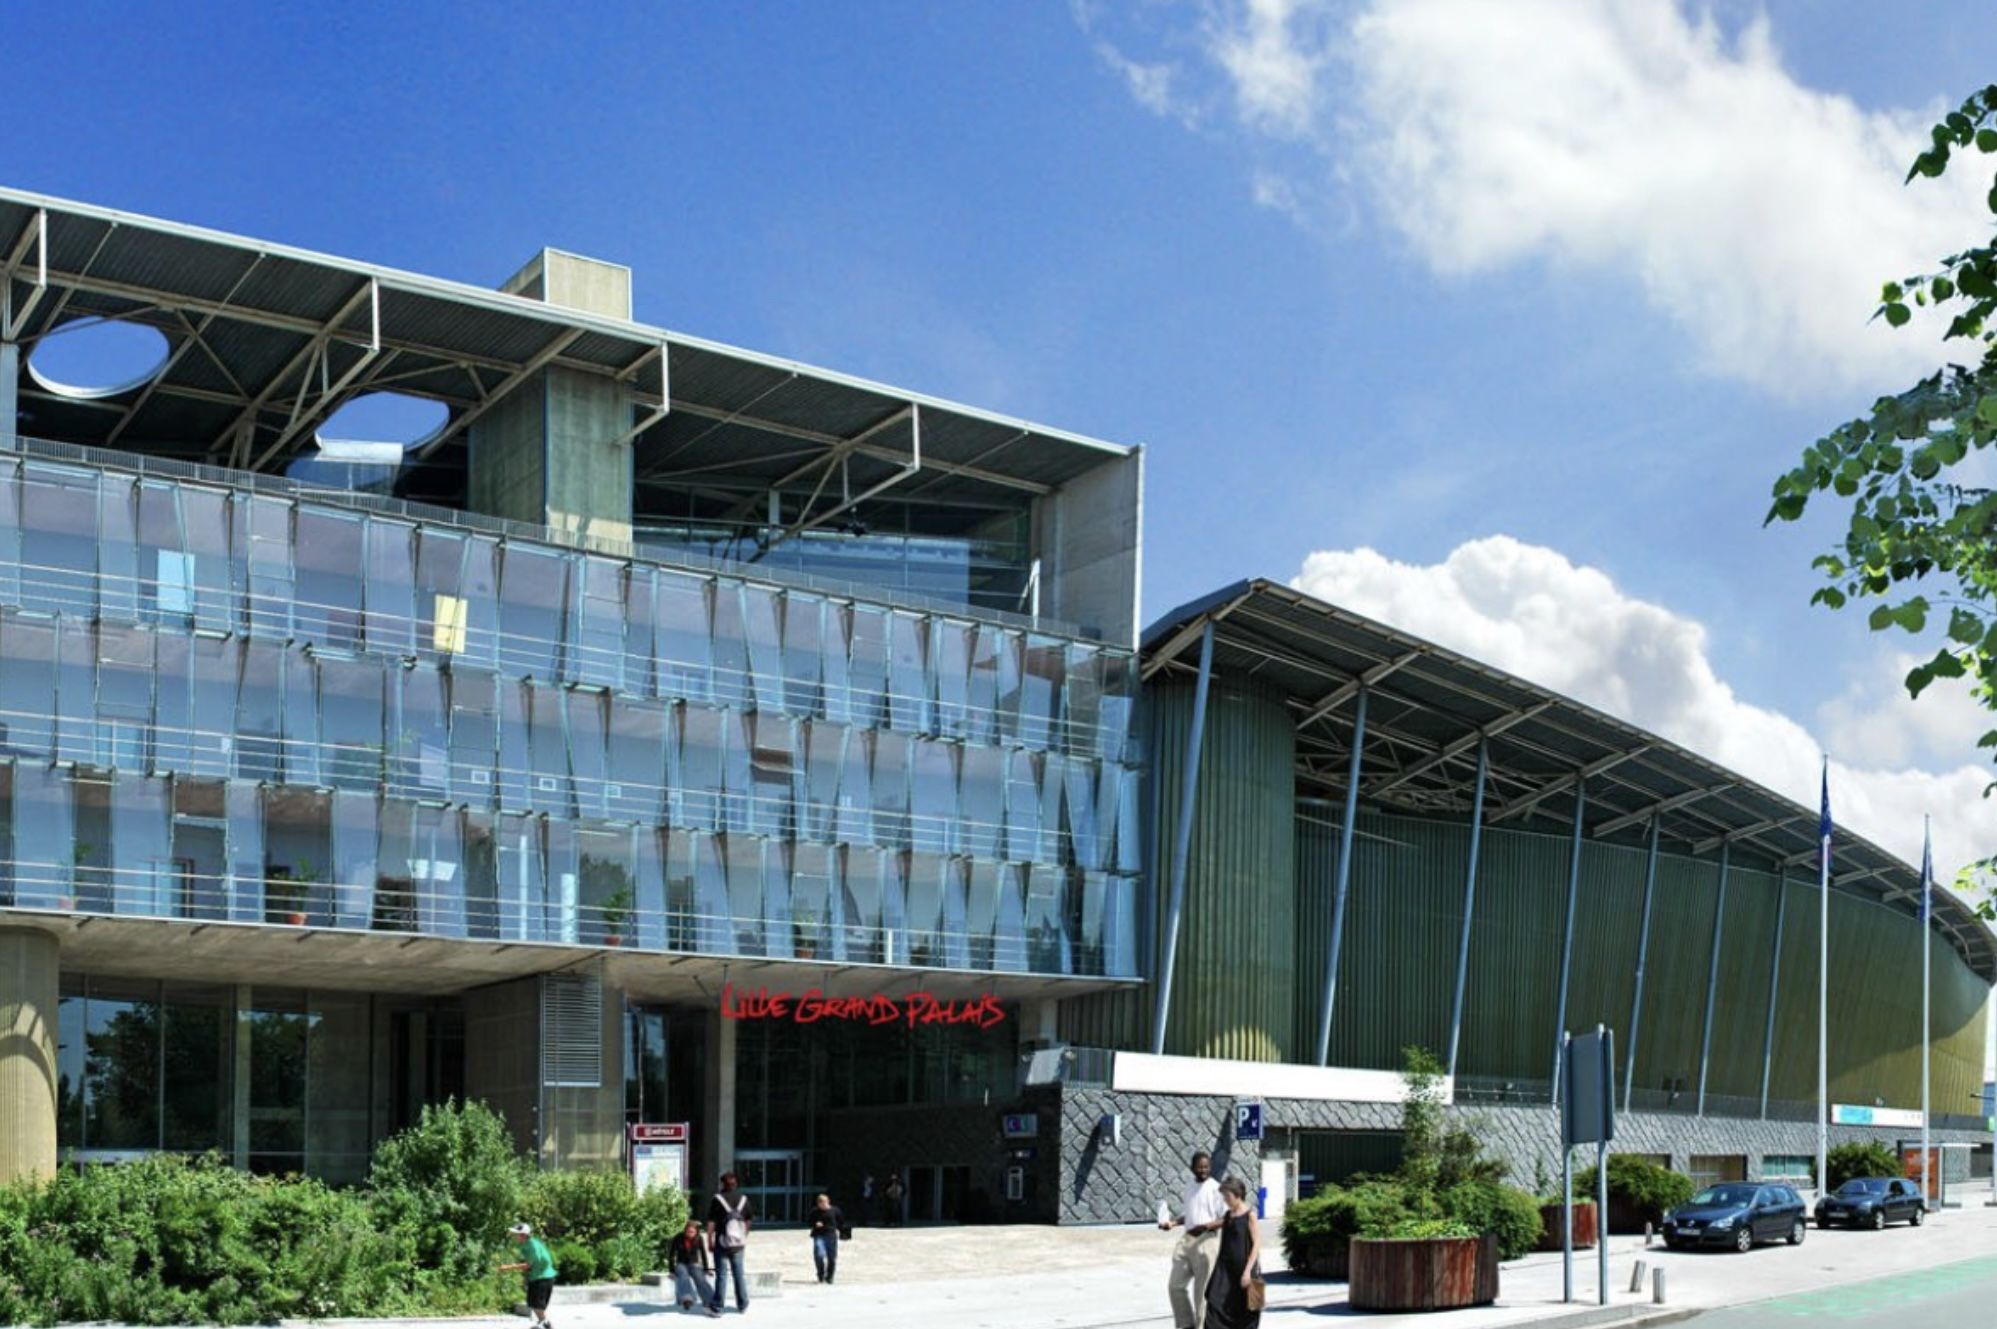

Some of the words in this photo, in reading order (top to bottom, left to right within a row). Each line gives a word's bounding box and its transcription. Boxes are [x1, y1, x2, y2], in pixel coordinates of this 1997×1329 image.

[793, 988, 900, 1025] GRAND
[904, 991, 1006, 1029] PALAIS
[1237, 1106, 1250, 1129] P
